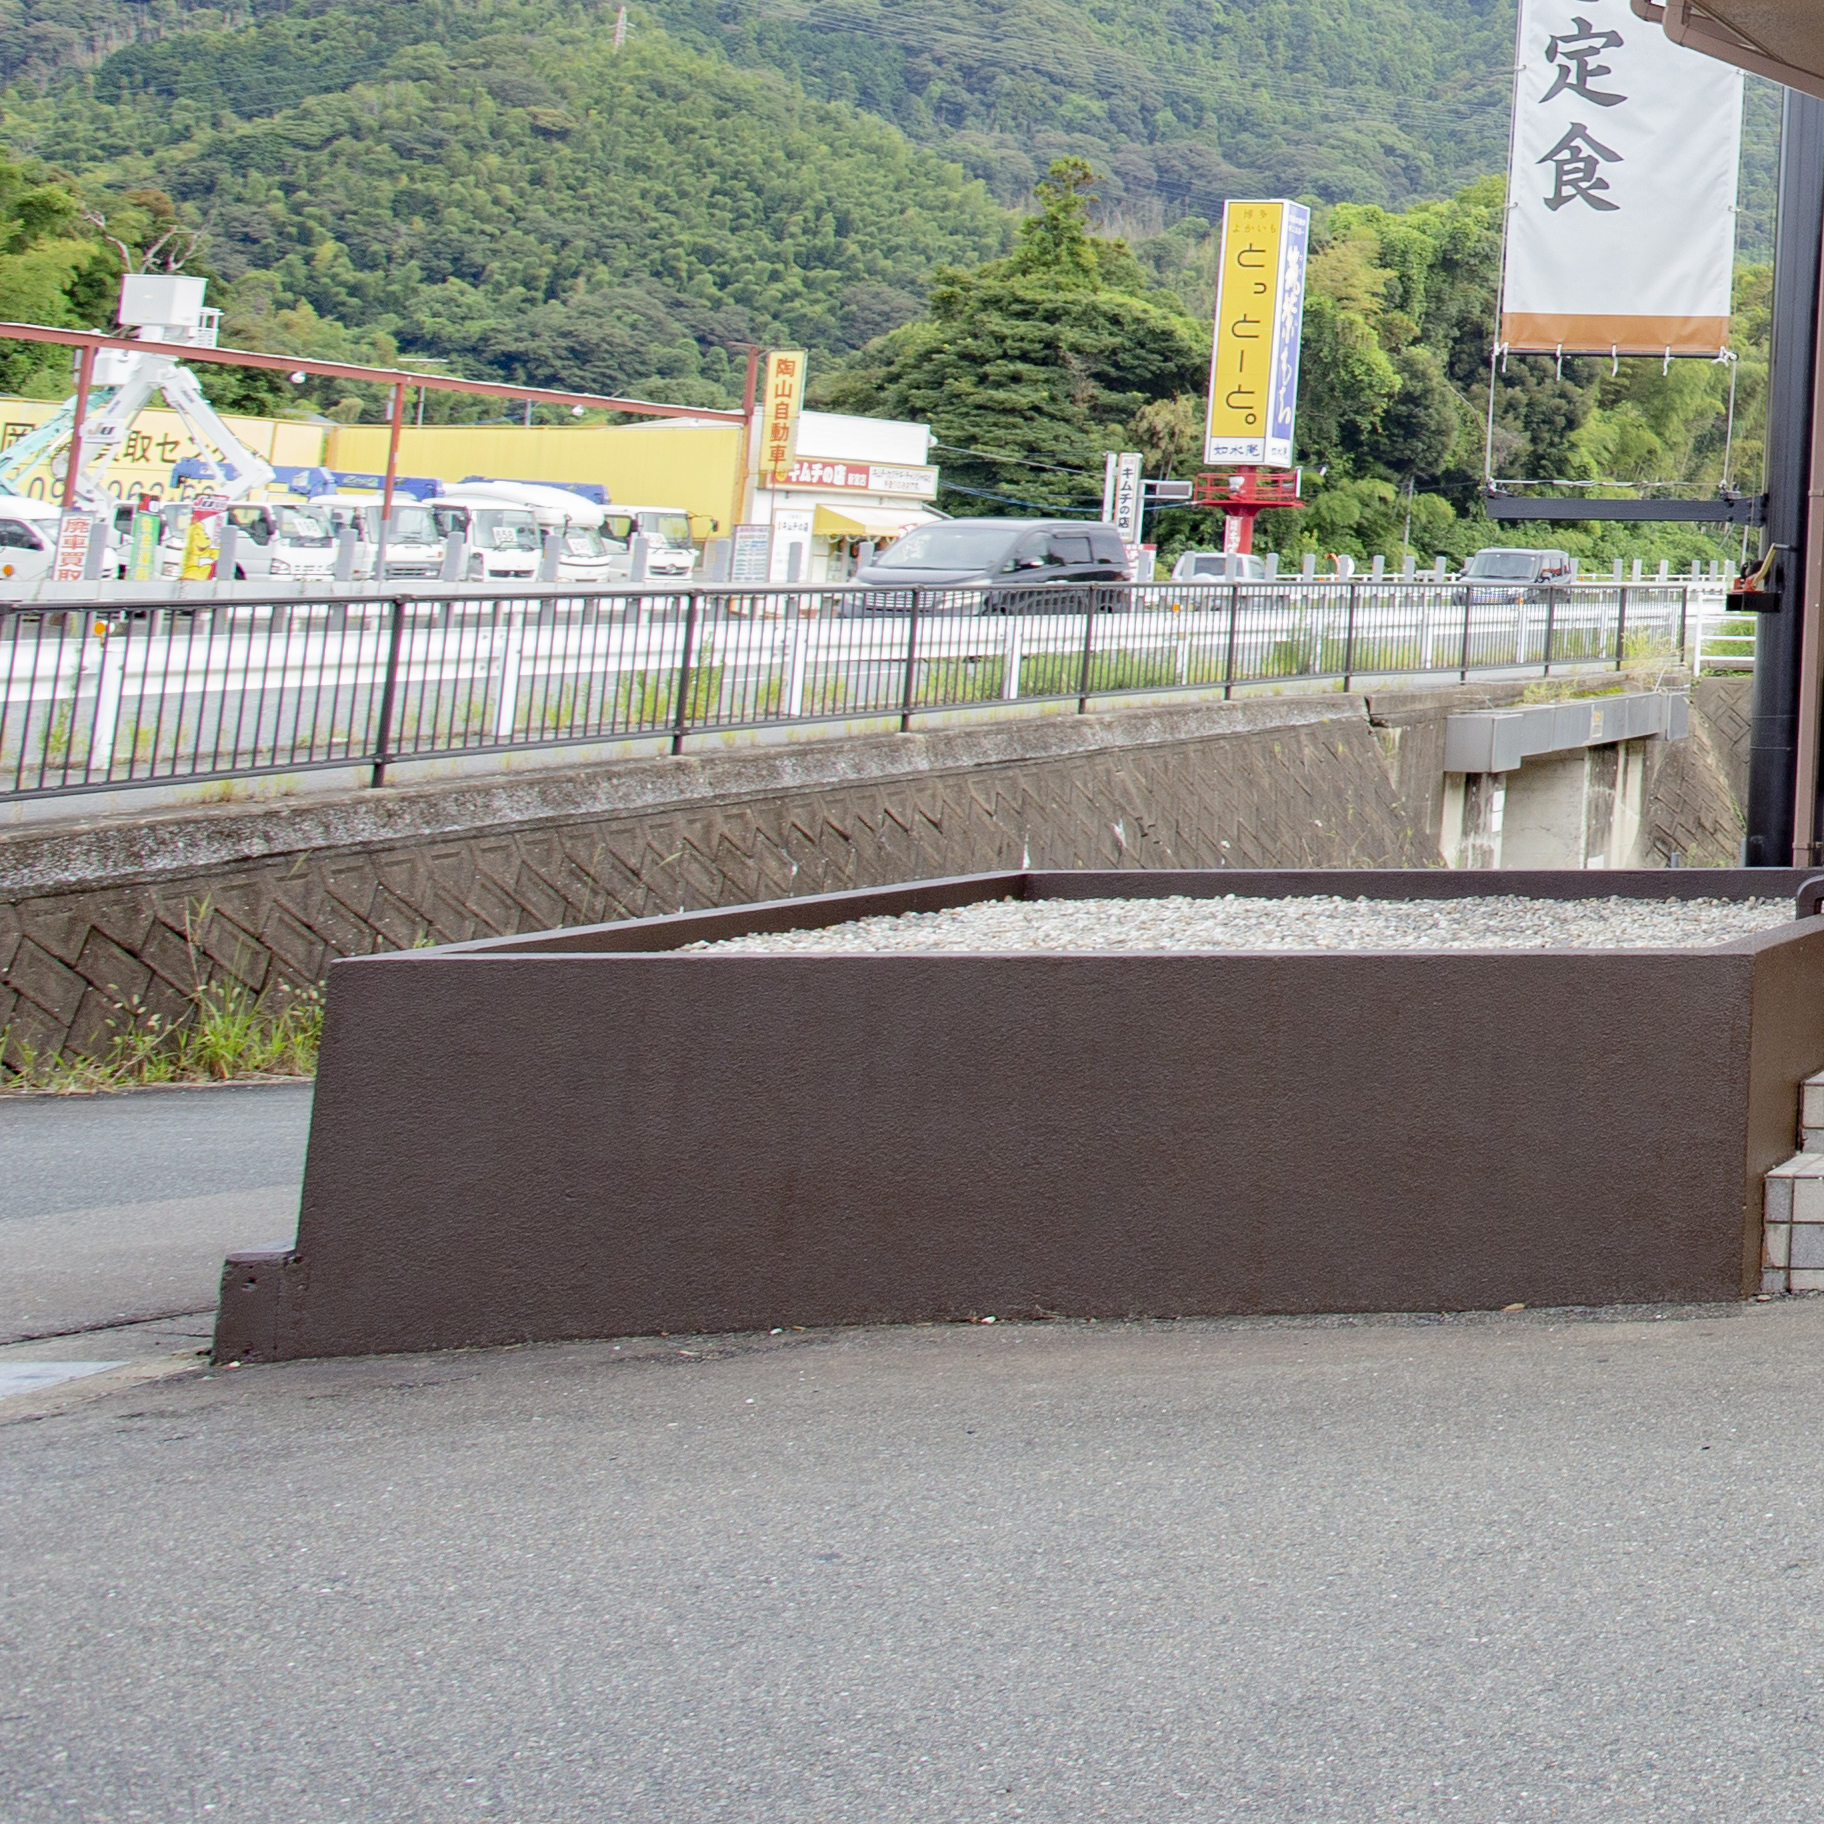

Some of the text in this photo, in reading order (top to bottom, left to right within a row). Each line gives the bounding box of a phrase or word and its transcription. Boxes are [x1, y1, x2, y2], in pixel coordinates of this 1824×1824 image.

[1225, 242, 1267, 425] とっとーと。
[768, 359, 796, 462] 陶山自動車
[1118, 467, 1134, 528] キムチの店
